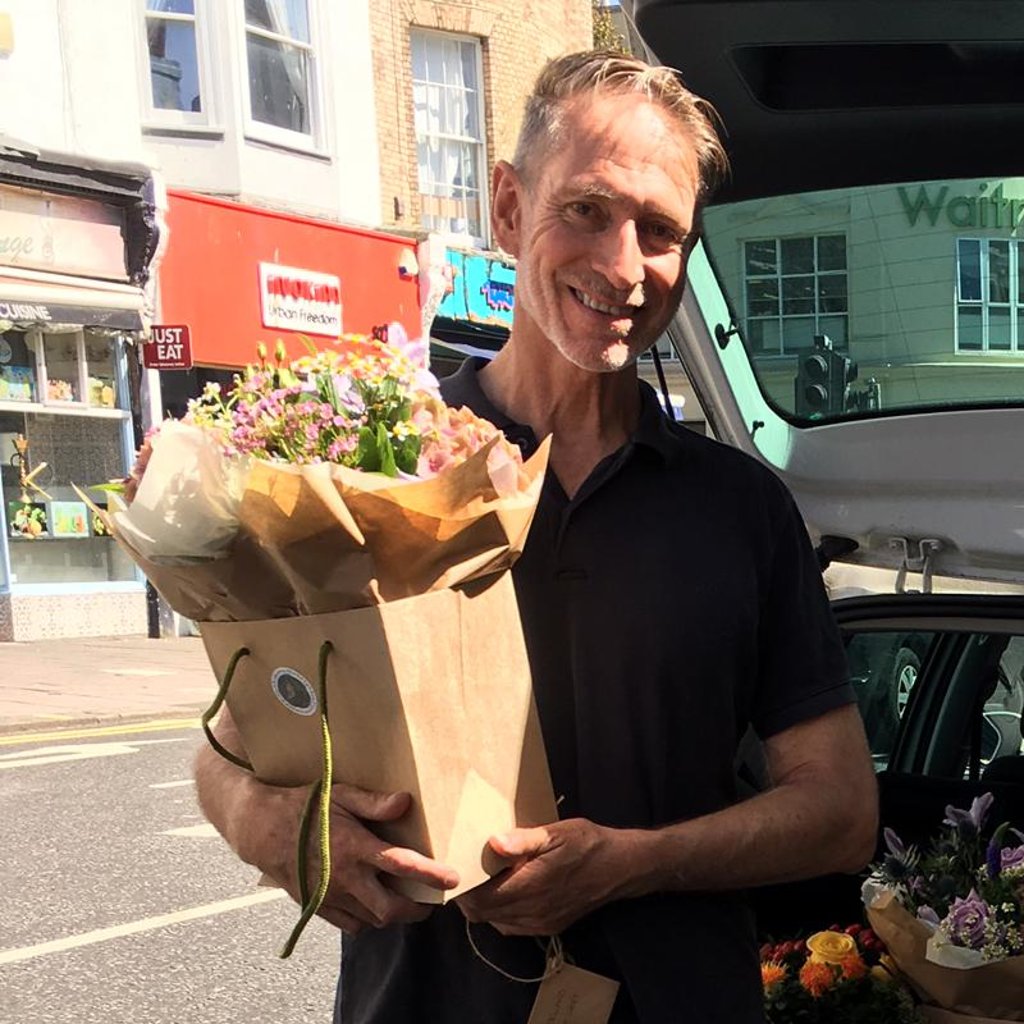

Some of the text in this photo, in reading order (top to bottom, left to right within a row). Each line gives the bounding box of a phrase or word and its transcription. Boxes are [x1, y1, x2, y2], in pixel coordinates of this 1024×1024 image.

[0, 303, 52, 320] CUISINE
[148, 328, 183, 344] JUST
[157, 344, 184, 360] EAT
